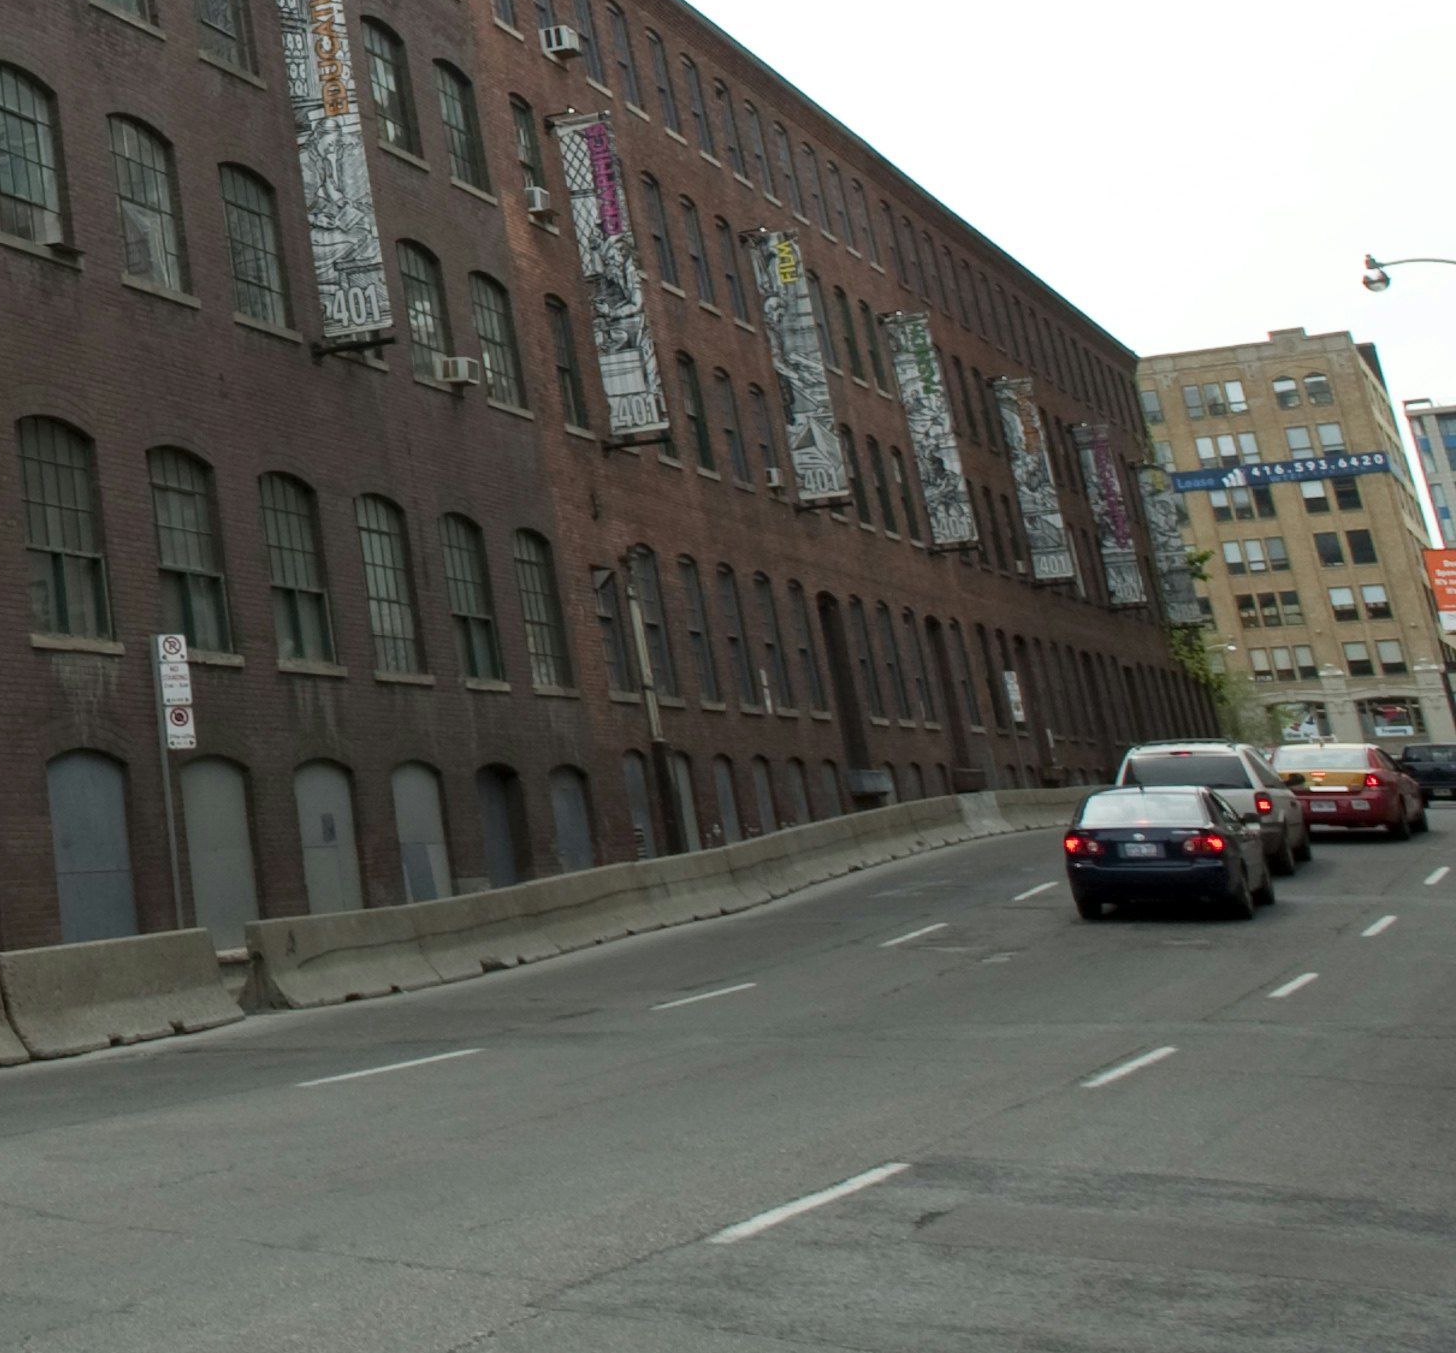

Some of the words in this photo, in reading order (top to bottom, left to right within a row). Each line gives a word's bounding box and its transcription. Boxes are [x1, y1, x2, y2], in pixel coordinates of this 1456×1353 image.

[585, 121, 623, 236] GRAPHICS
[775, 240, 800, 284] FILM
[332, 284, 381, 327] 401
[617, 393, 660, 428] 401
[803, 467, 840, 495] 401
[1176, 477, 1216, 490] Lease
[1038, 553, 1069, 575] 401
